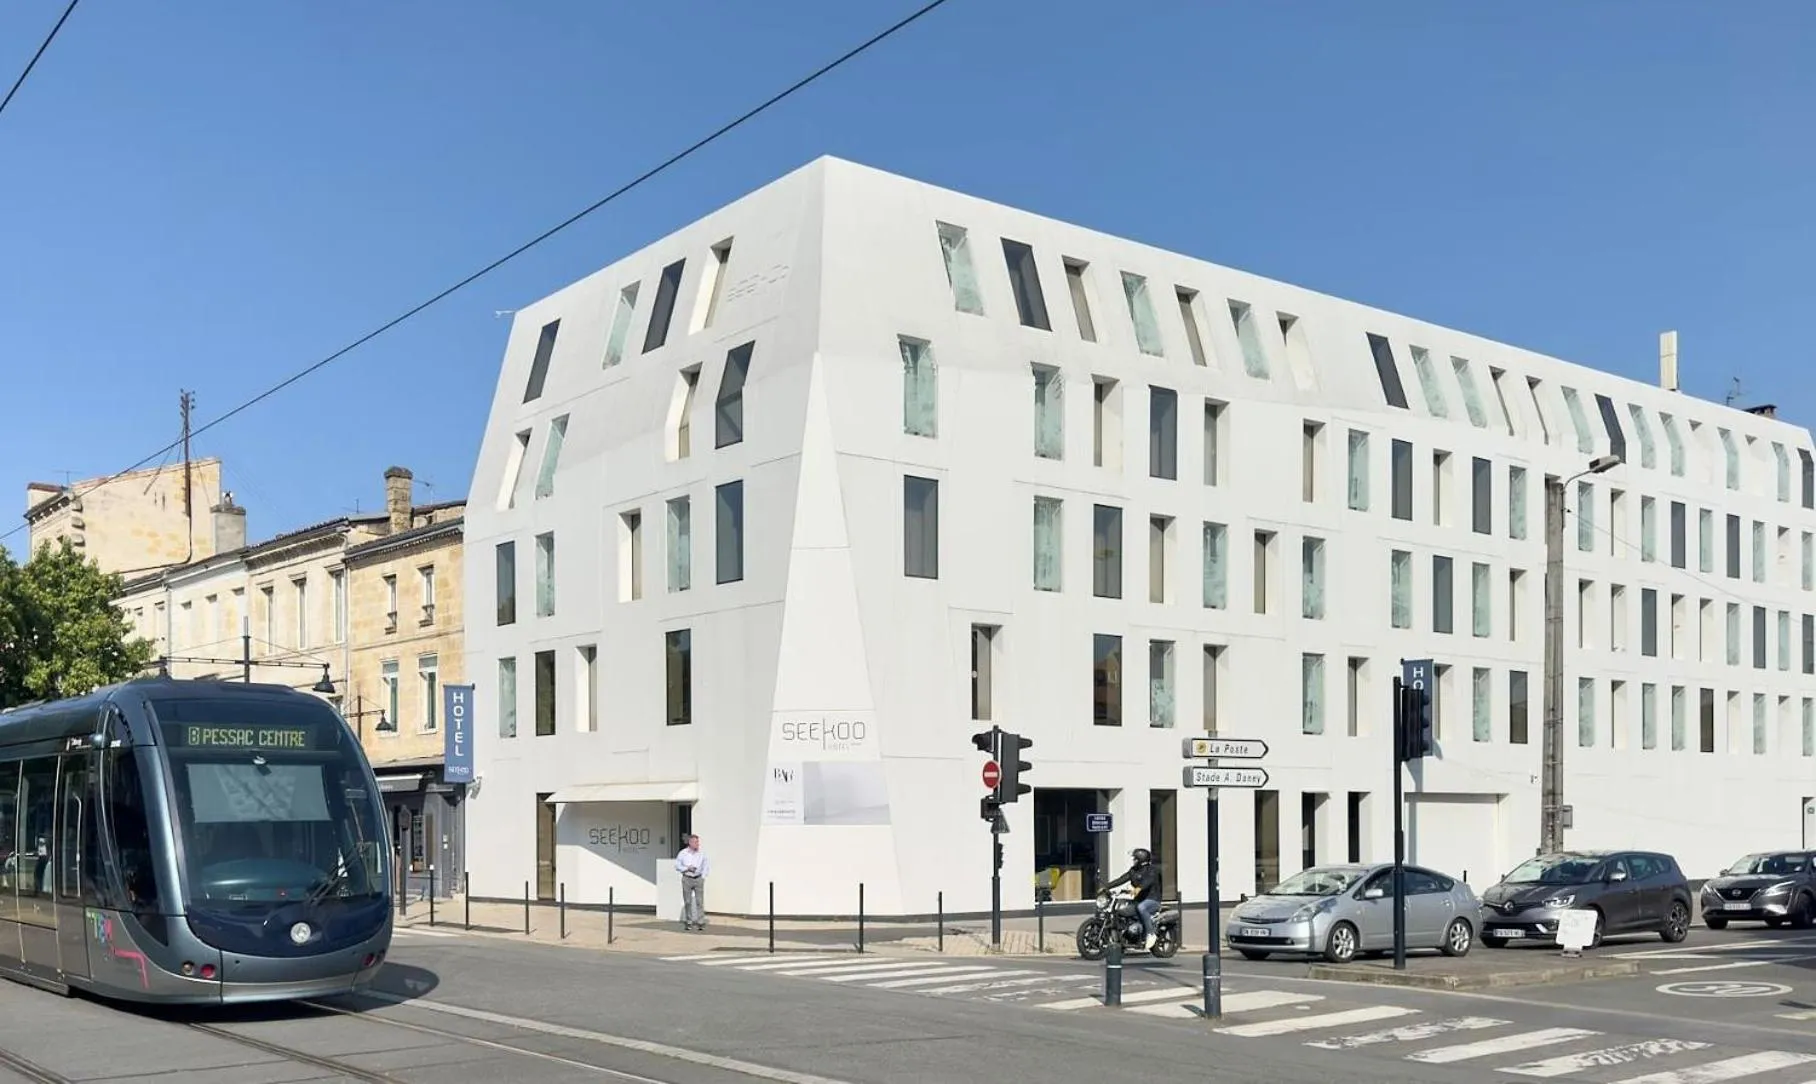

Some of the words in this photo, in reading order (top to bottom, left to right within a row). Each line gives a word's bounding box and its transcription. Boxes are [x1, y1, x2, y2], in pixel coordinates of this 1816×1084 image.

[453, 692, 464, 756] HOTEL
[203, 728, 253, 746] PESSAC
[259, 730, 305, 747] CENTRE
[1210, 744, 1219, 753] La
[1224, 744, 1248, 754] Poste
[1196, 772, 1220, 782] Stade
